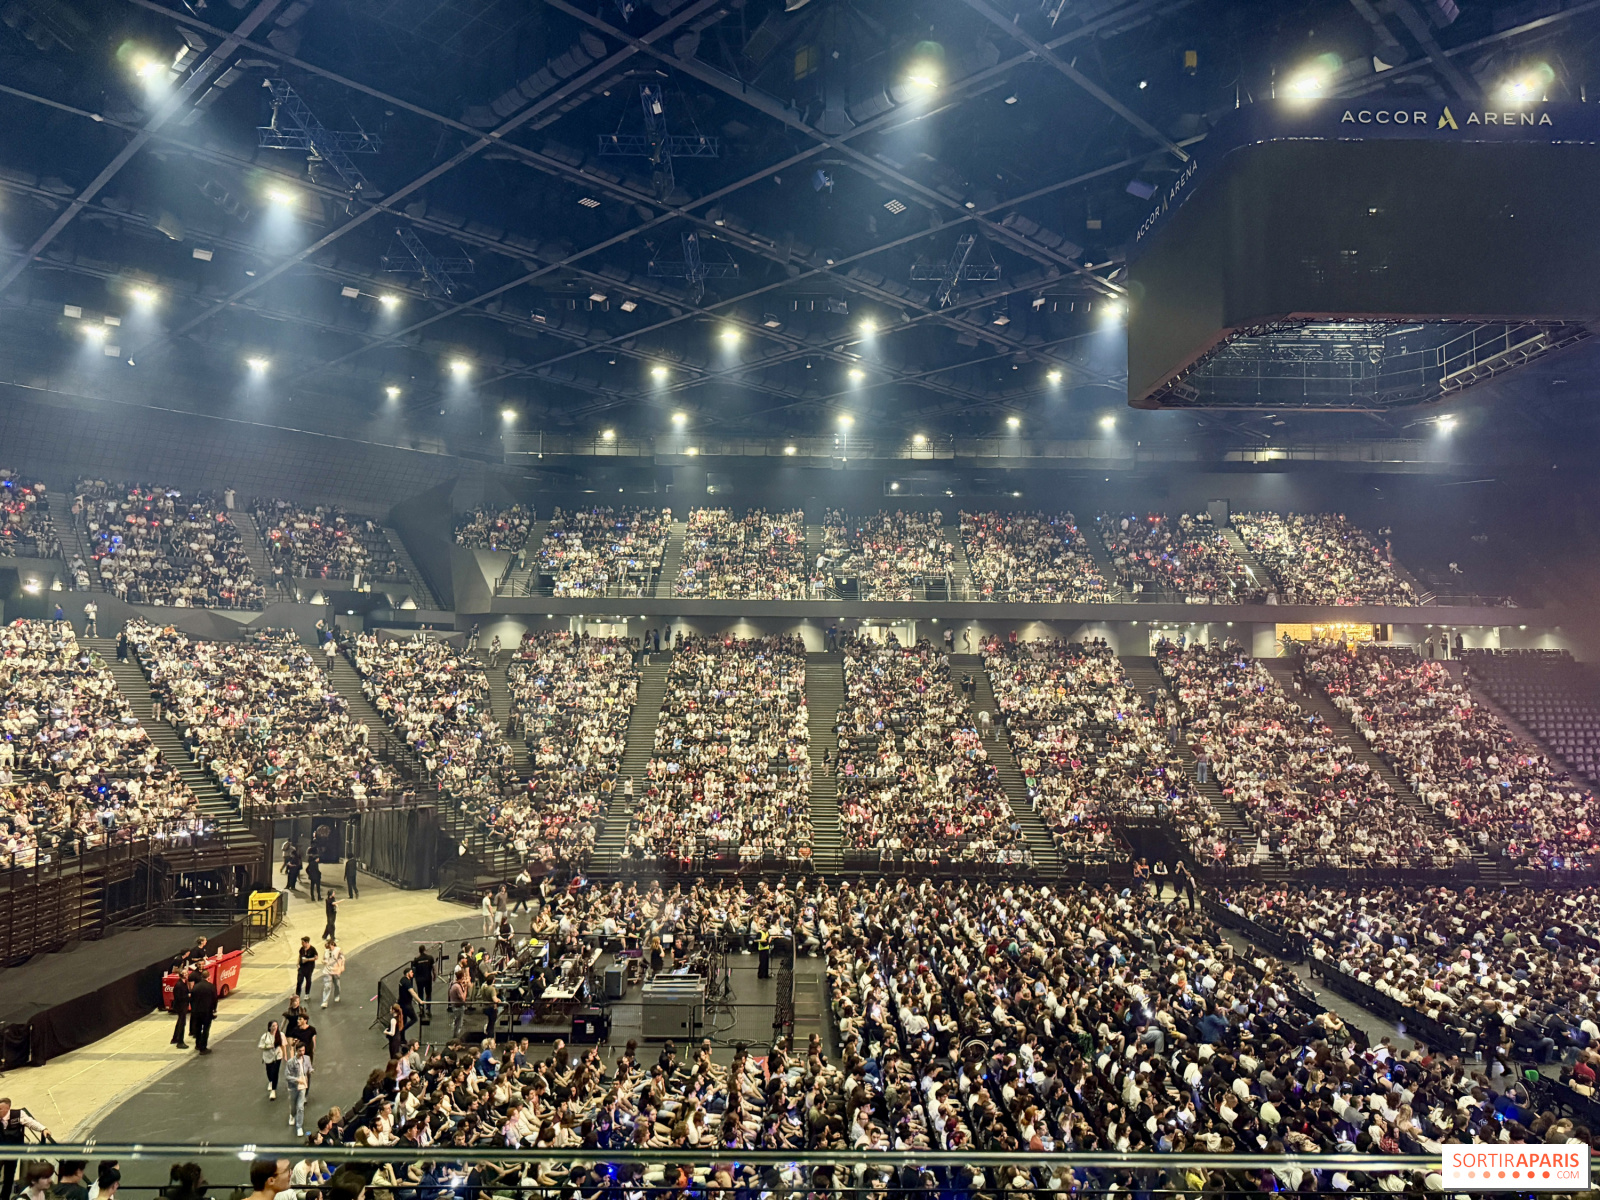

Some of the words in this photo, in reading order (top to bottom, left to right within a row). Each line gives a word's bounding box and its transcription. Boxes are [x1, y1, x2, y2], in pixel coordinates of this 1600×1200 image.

[1341, 110, 1428, 124] ACCOR
[1466, 112, 1553, 126] ARENA
[1136, 206, 1160, 243] ACCOR
[1169, 160, 1198, 201] ARENA
